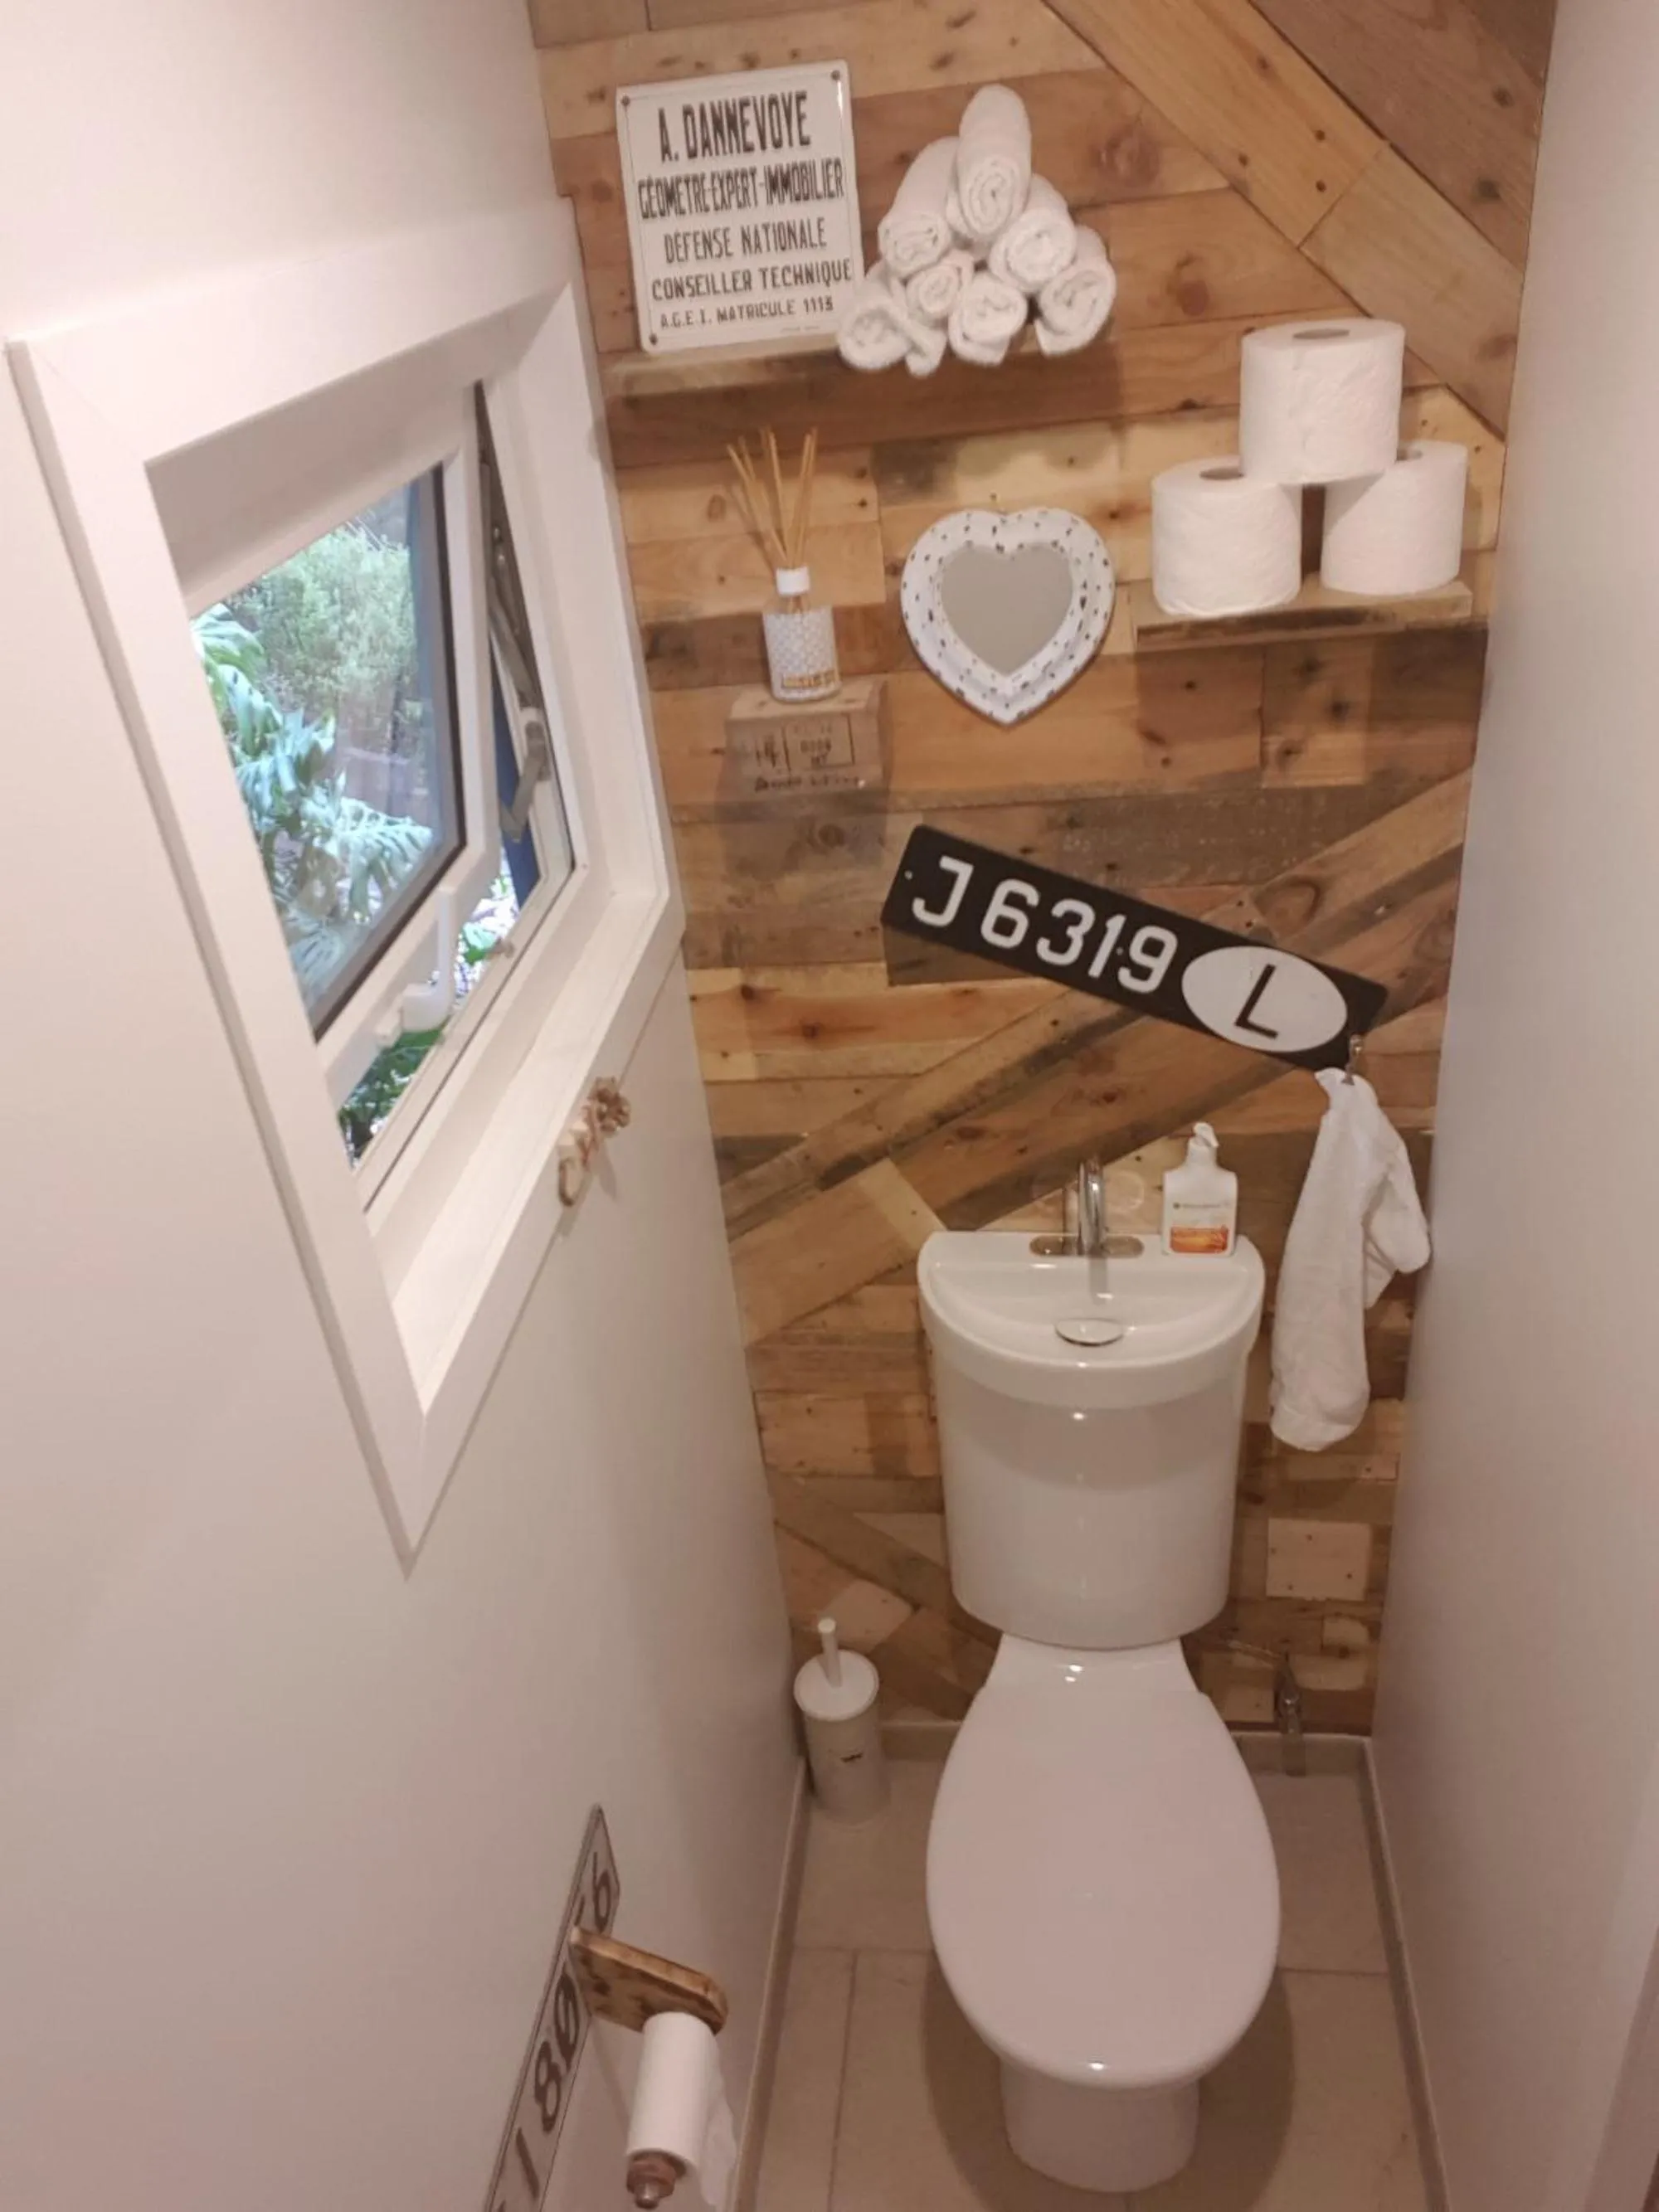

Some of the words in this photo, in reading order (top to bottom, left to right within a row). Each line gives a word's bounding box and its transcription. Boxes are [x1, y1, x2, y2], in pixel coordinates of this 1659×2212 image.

[658, 106, 679, 163] A.
[682, 90, 811, 159] DANNEVOYE
[740, 216, 828, 256] NATIONALE
[651, 270, 752, 301] CONSEILLER
[758, 258, 853, 288] TECHNIQUE
[716, 299, 796, 325] MATRICULE
[1233, 962, 1279, 1040] L
